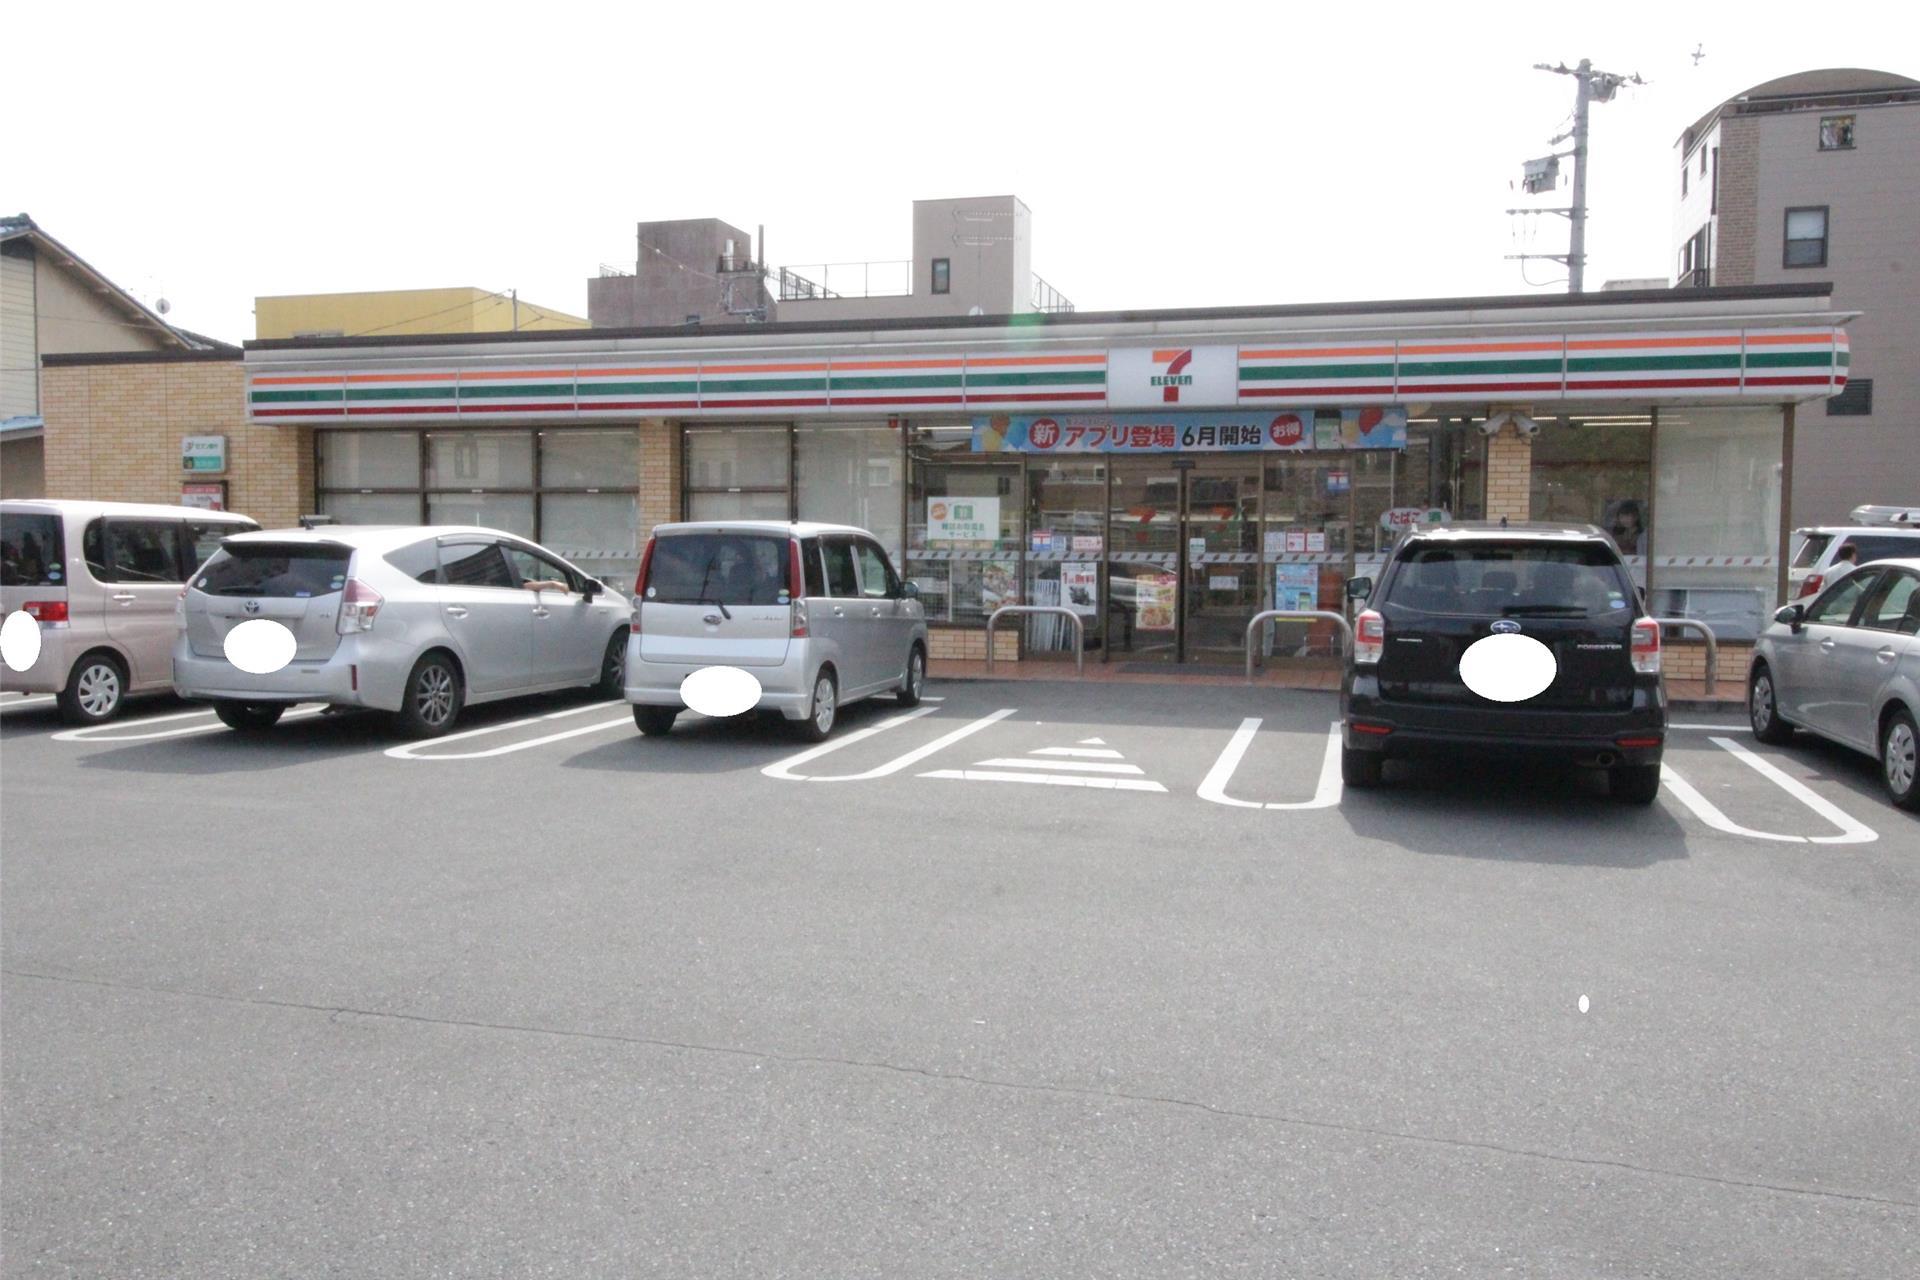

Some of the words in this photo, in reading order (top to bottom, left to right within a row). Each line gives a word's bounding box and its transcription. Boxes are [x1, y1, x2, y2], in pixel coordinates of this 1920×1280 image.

[1152, 349, 1192, 402] 7
[1034, 423, 1055, 444] 新
[1066, 424, 1176, 447] アプリ登場
[1181, 424, 1261, 446] 6月開始
[1272, 421, 1300, 438] お得
[1389, 511, 1421, 525] たばこ
